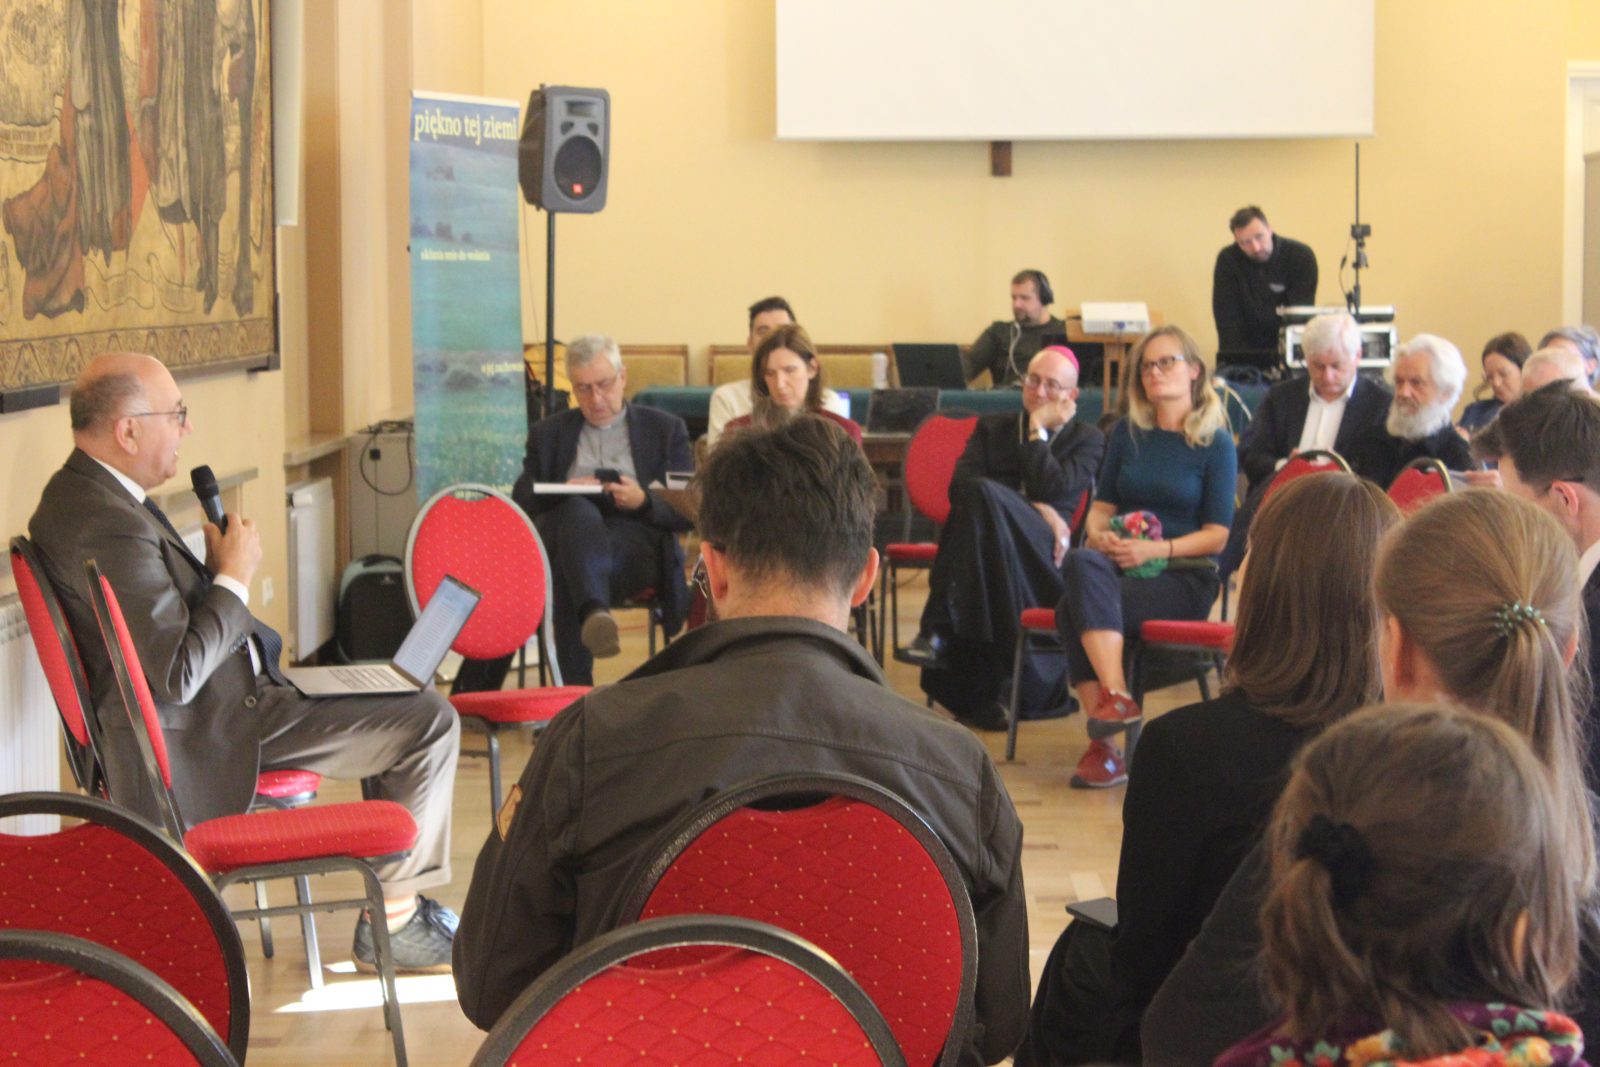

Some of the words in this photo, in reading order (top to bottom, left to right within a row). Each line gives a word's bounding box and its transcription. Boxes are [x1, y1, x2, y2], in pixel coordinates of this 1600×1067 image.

[414, 108, 462, 142] piękno
[464, 114, 481, 147] tej
[483, 115, 518, 140] ziemi
